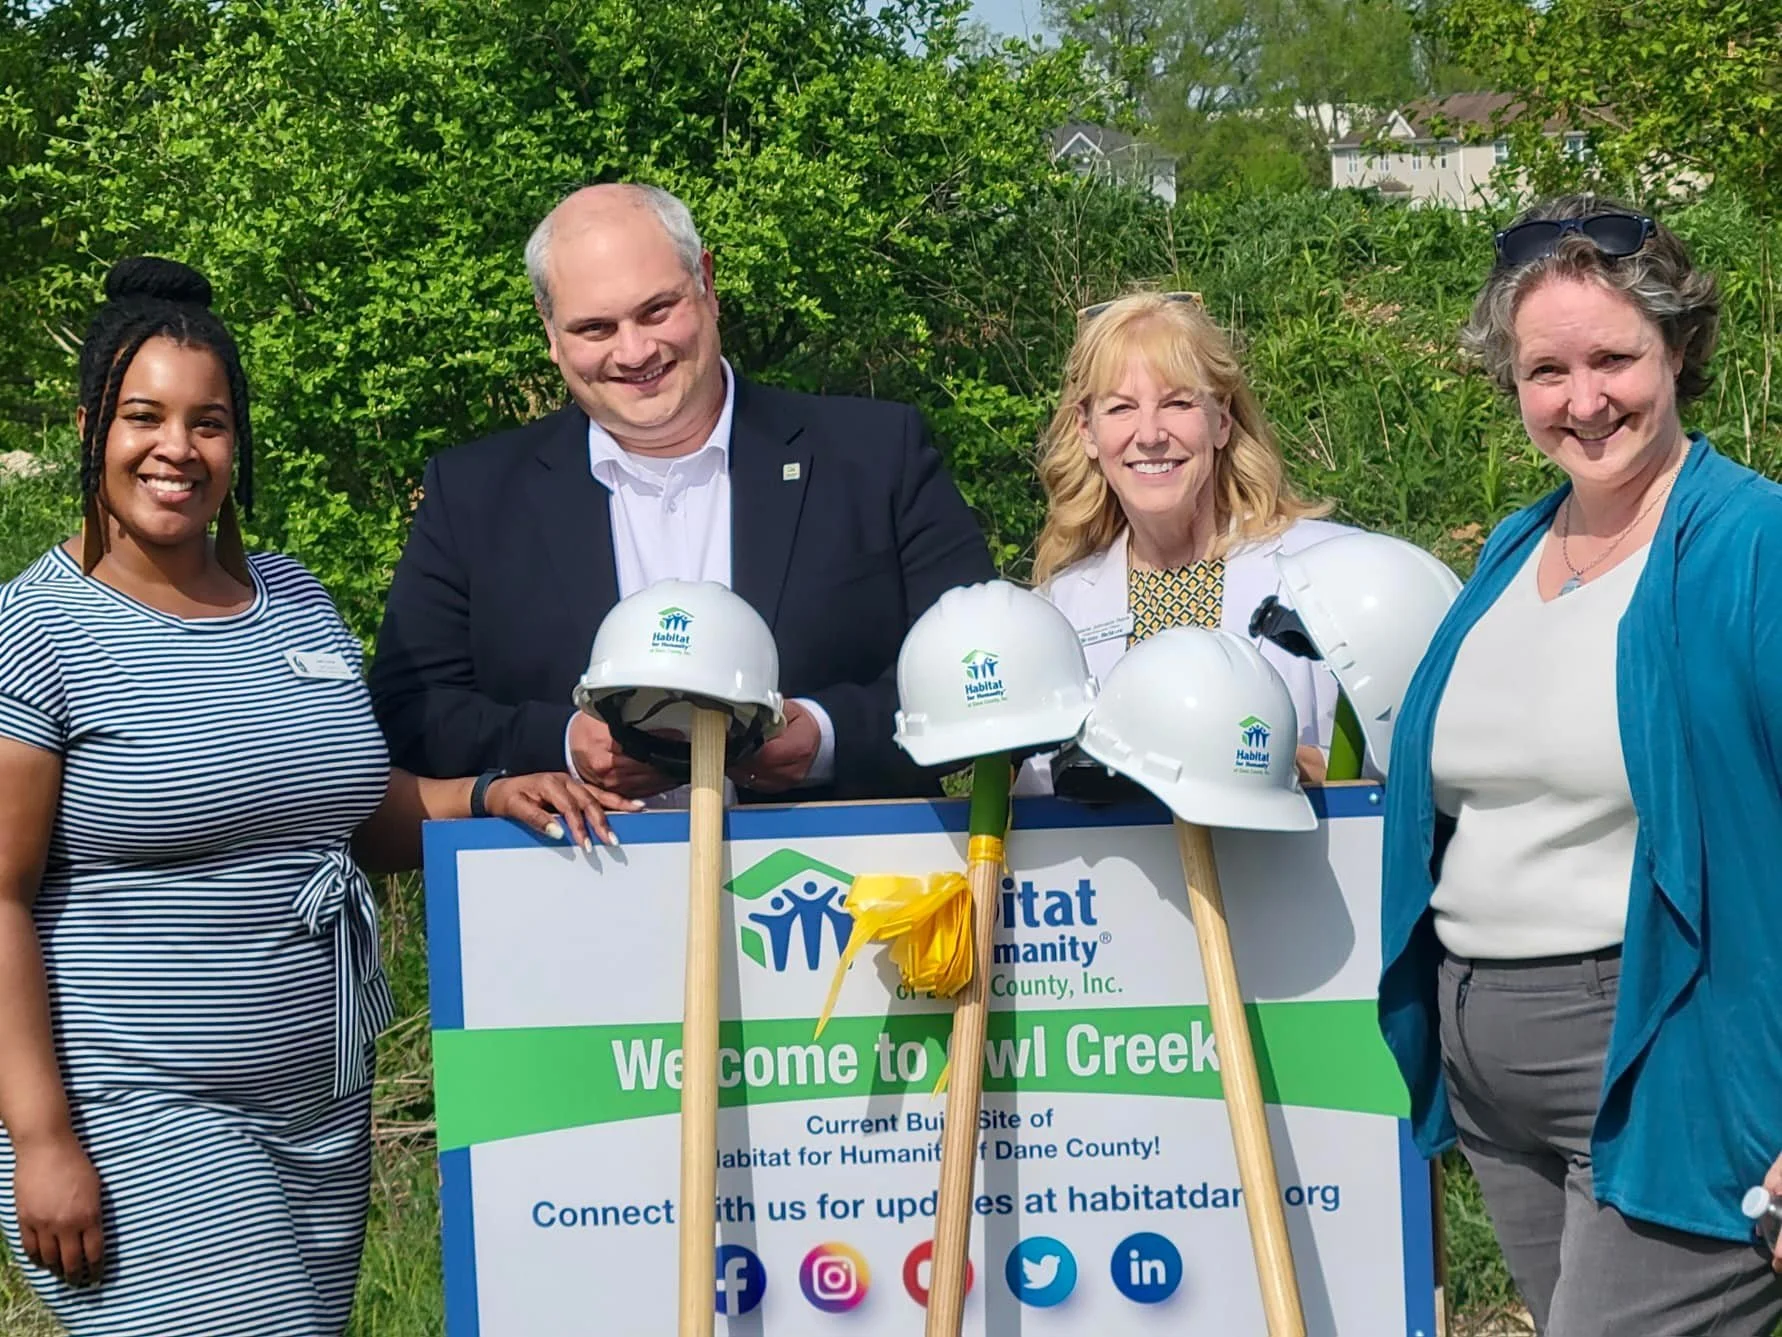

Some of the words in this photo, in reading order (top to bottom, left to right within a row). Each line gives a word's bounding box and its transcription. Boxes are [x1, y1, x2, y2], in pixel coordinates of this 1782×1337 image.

[652, 632, 690, 644] Habitat
[965, 680, 1004, 694] Habitat
[1236, 749, 1269, 761] Habitat
[998, 876, 1098, 929] itat
[990, 973, 1075, 999] County,
[1082, 971, 1124, 994] Inc.
[611, 1038, 859, 1091] Wecome
[873, 1032, 929, 1083] to
[948, 1025, 1047, 1080] wl
[1065, 1020, 1222, 1078] Creek
[806, 1113, 898, 1135] Current
[906, 1111, 945, 1132] Bui
[978, 1110, 1022, 1130] Site
[1030, 1108, 1054, 1128] of
[798, 1146, 832, 1166] for
[840, 1142, 943, 1165] Humanit
[995, 1140, 1058, 1161] Dane
[1065, 1135, 1160, 1160] County!
[532, 1199, 675, 1228] Connect
[715, 1195, 755, 1223] ith
[767, 1199, 807, 1221] us
[817, 1192, 864, 1219] for
[875, 1189, 1013, 1224] updes
[1024, 1187, 1058, 1214] at
